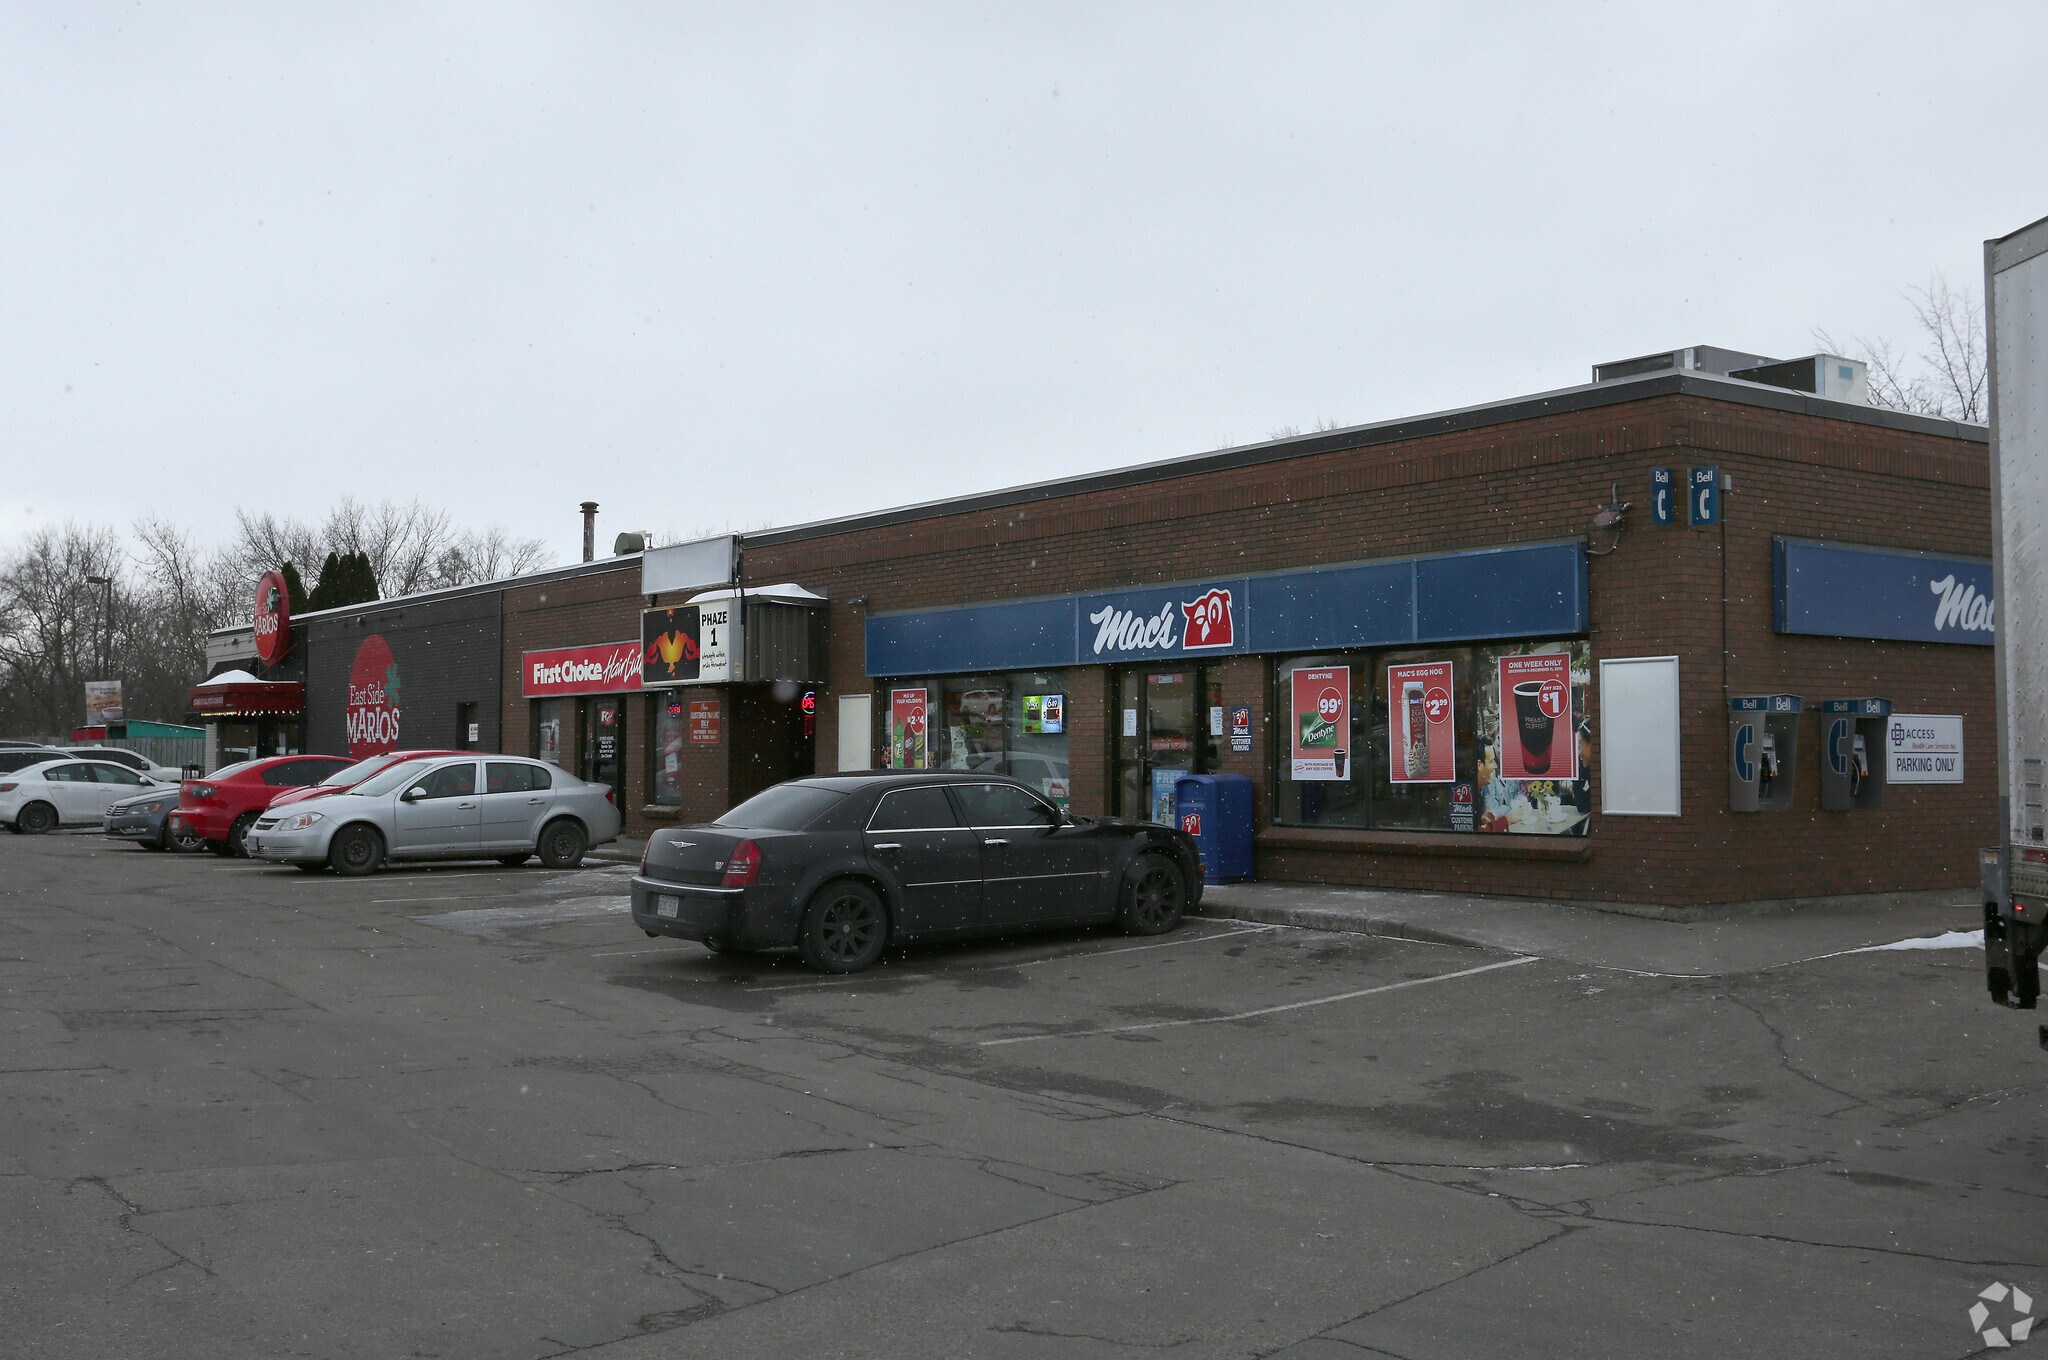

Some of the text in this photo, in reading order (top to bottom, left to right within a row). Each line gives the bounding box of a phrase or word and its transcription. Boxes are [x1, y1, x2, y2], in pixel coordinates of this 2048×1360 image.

[1655, 470, 1669, 483] Bell
[1696, 470, 1713, 483] Bell
[701, 611, 728, 626] PHAZE
[1090, 601, 1178, 655] Mac's
[710, 627, 718, 647] 1
[533, 663, 561, 685] First
[562, 659, 603, 682] Choice
[349, 681, 385, 706] East Side
[1542, 691, 1560, 713] $1
[1742, 699, 1757, 709] Bell
[1775, 696, 1791, 711] Bell
[1833, 701, 1848, 711] Bell
[1866, 699, 1881, 714] Bell
[346, 706, 400, 744] MARIOS
[1308, 725, 1335, 743] Dentyne
[1905, 729, 1936, 740] ACCESS
[1896, 757, 1956, 772] PARKING ONLY
